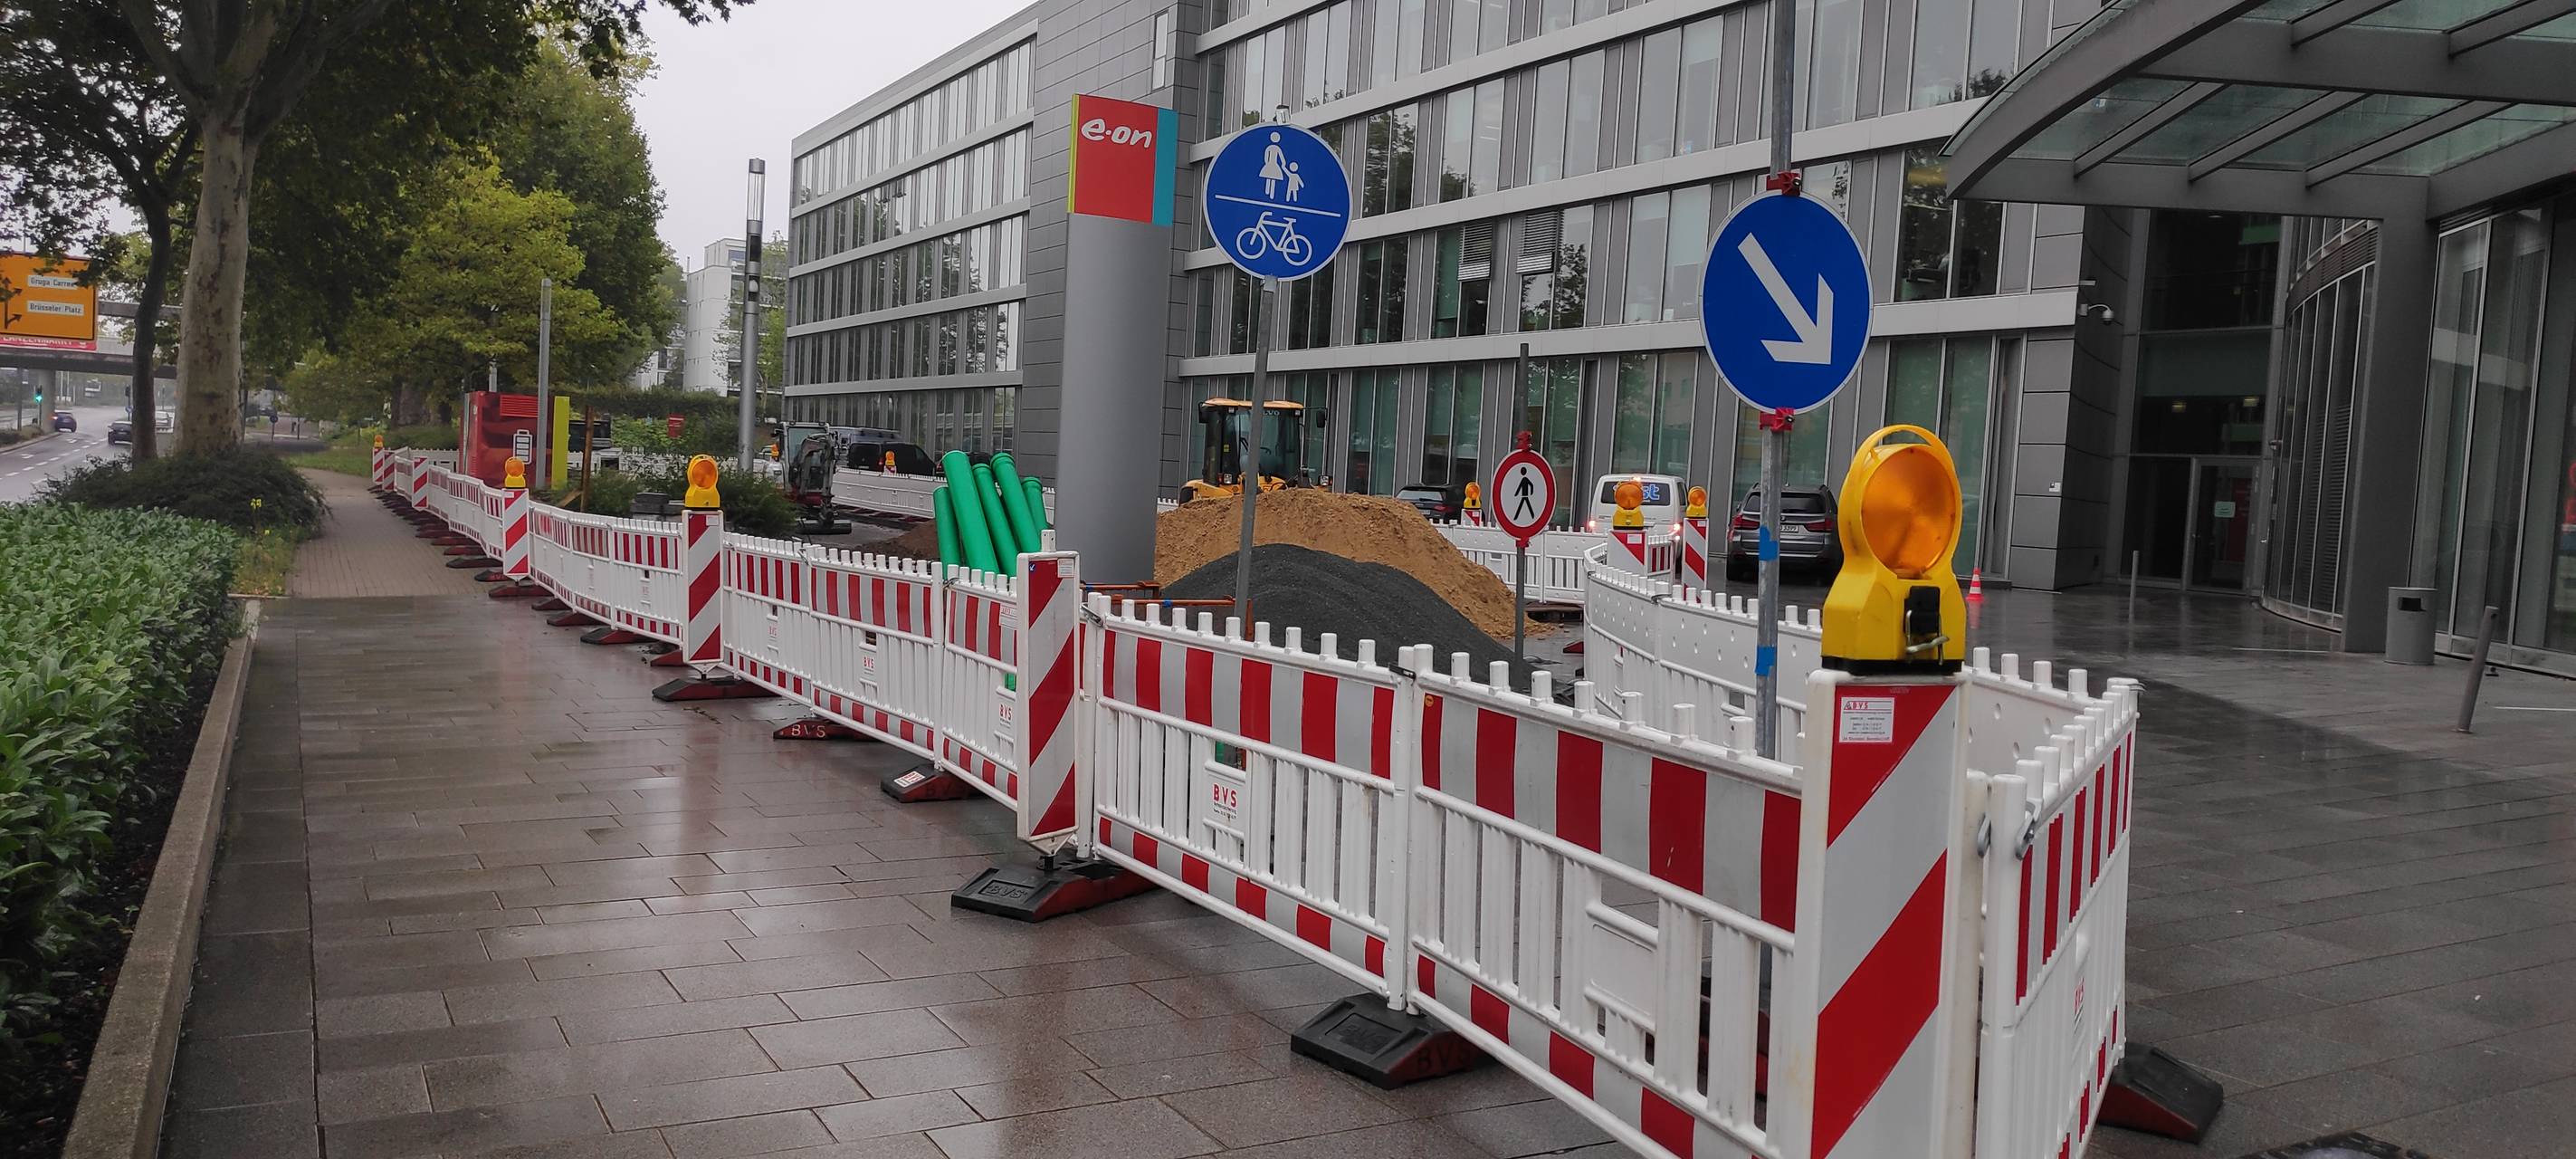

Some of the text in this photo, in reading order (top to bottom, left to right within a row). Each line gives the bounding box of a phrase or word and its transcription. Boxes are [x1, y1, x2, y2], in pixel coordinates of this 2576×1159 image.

[31, 277, 51, 287] Gruga
[64, 305, 81, 314] Platz
[999, 704, 1011, 721] BVS
[791, 723, 825, 738] BVS
[1213, 783, 1237, 808] BVS
